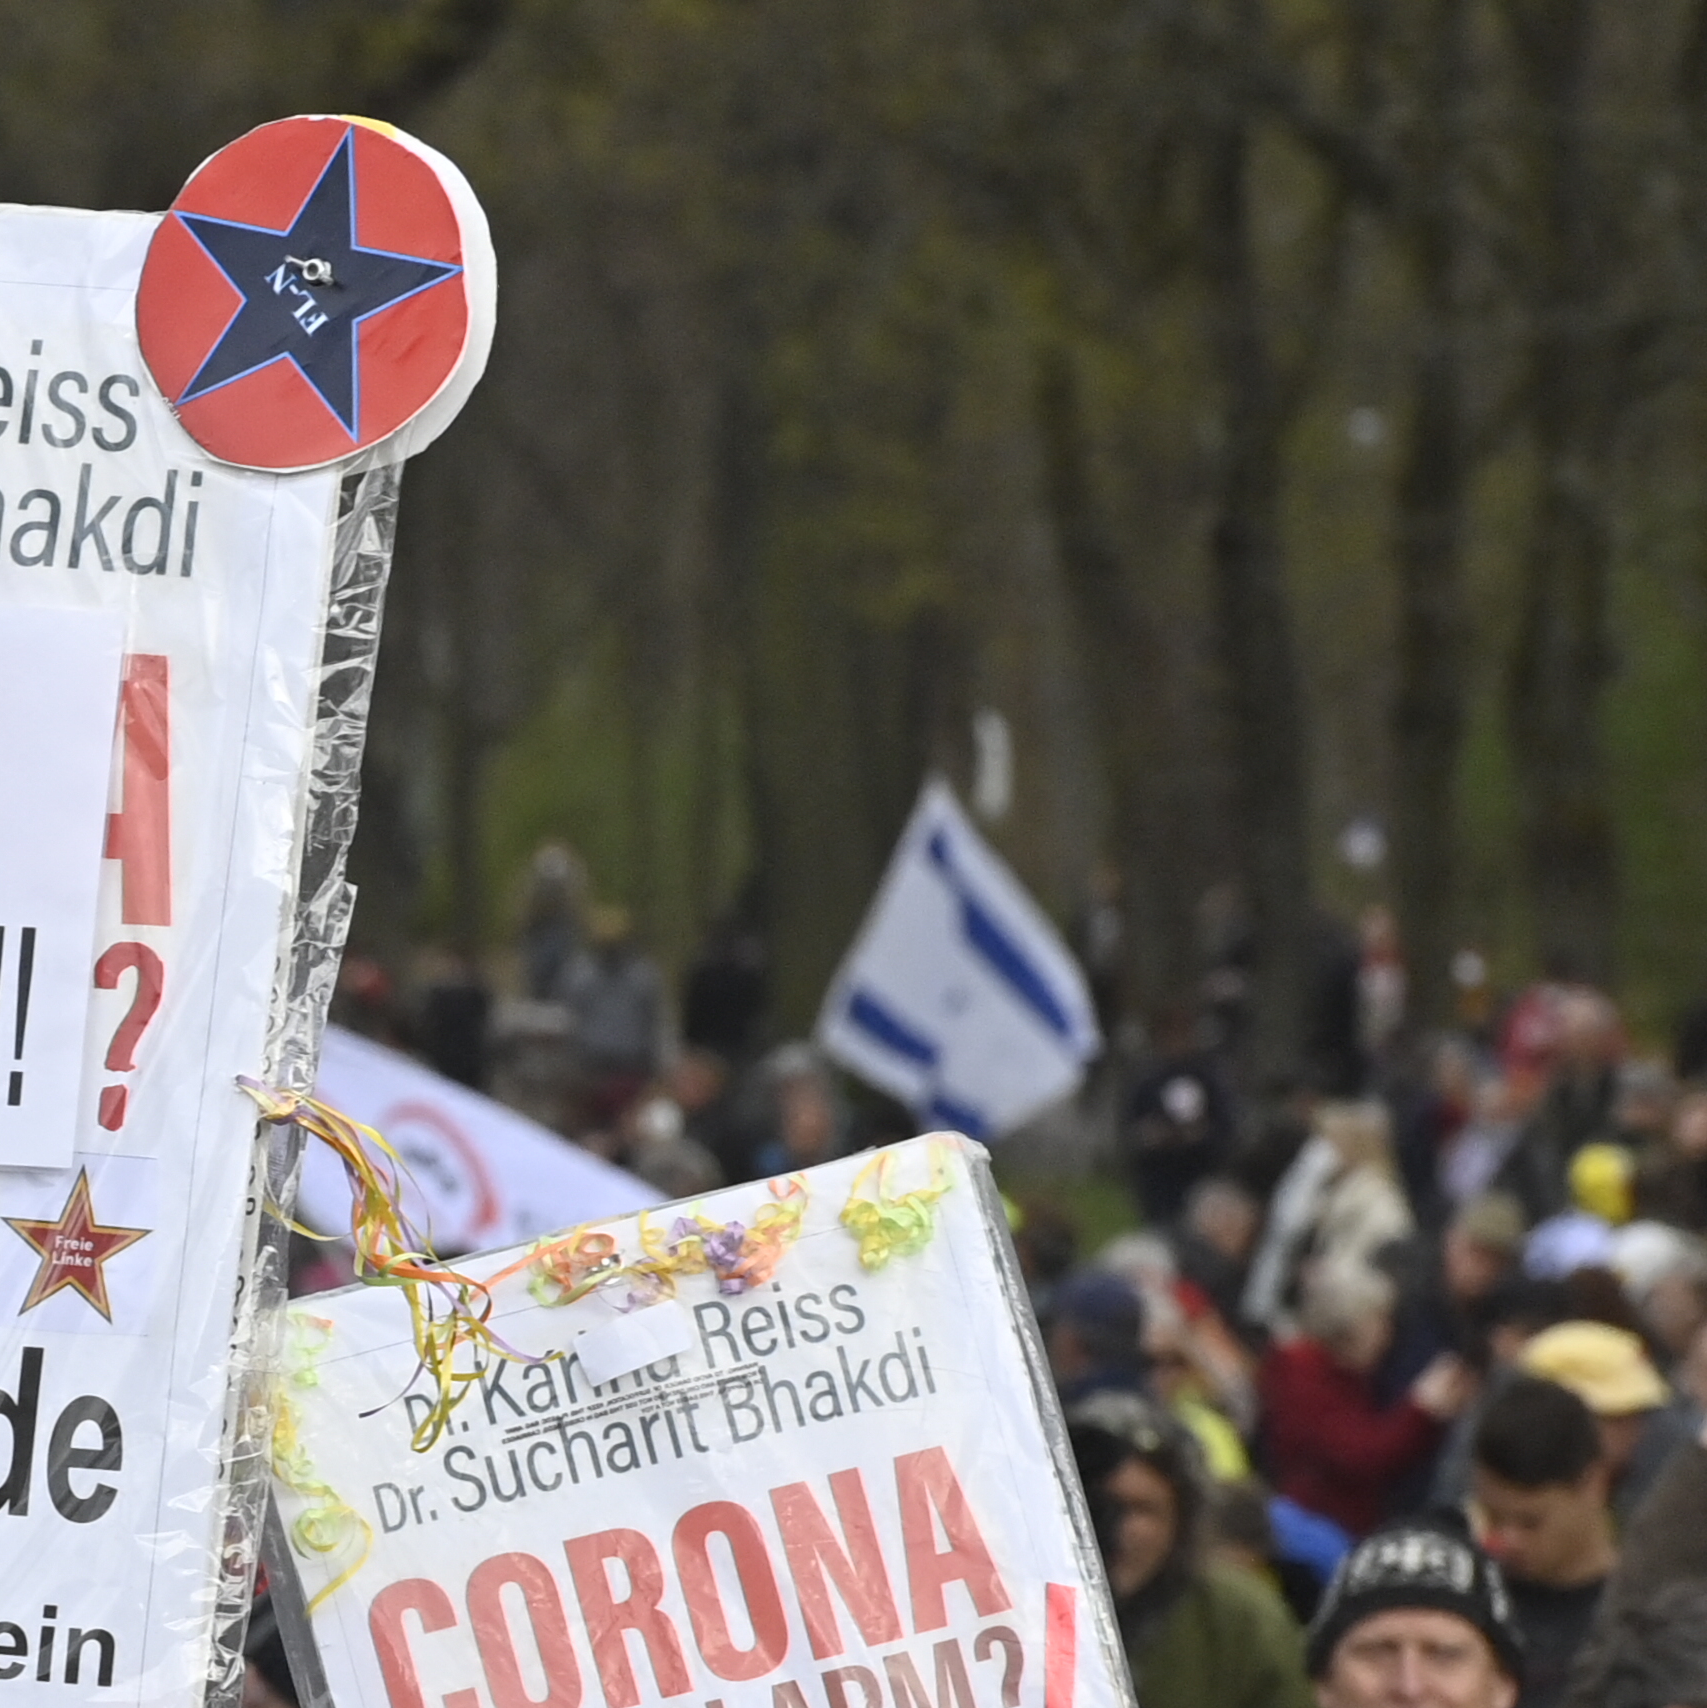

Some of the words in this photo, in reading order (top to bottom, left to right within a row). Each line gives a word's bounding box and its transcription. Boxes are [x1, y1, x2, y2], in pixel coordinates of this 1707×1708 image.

[51, 1250, 95, 1268] Linke
[54, 1235, 95, 1252] Freie
[693, 1281, 867, 1370] Reiss
[371, 1482, 438, 1535] Dr.
[442, 1393, 709, 1514] Sucharit
[713, 1326, 938, 1445] Bhakdi
